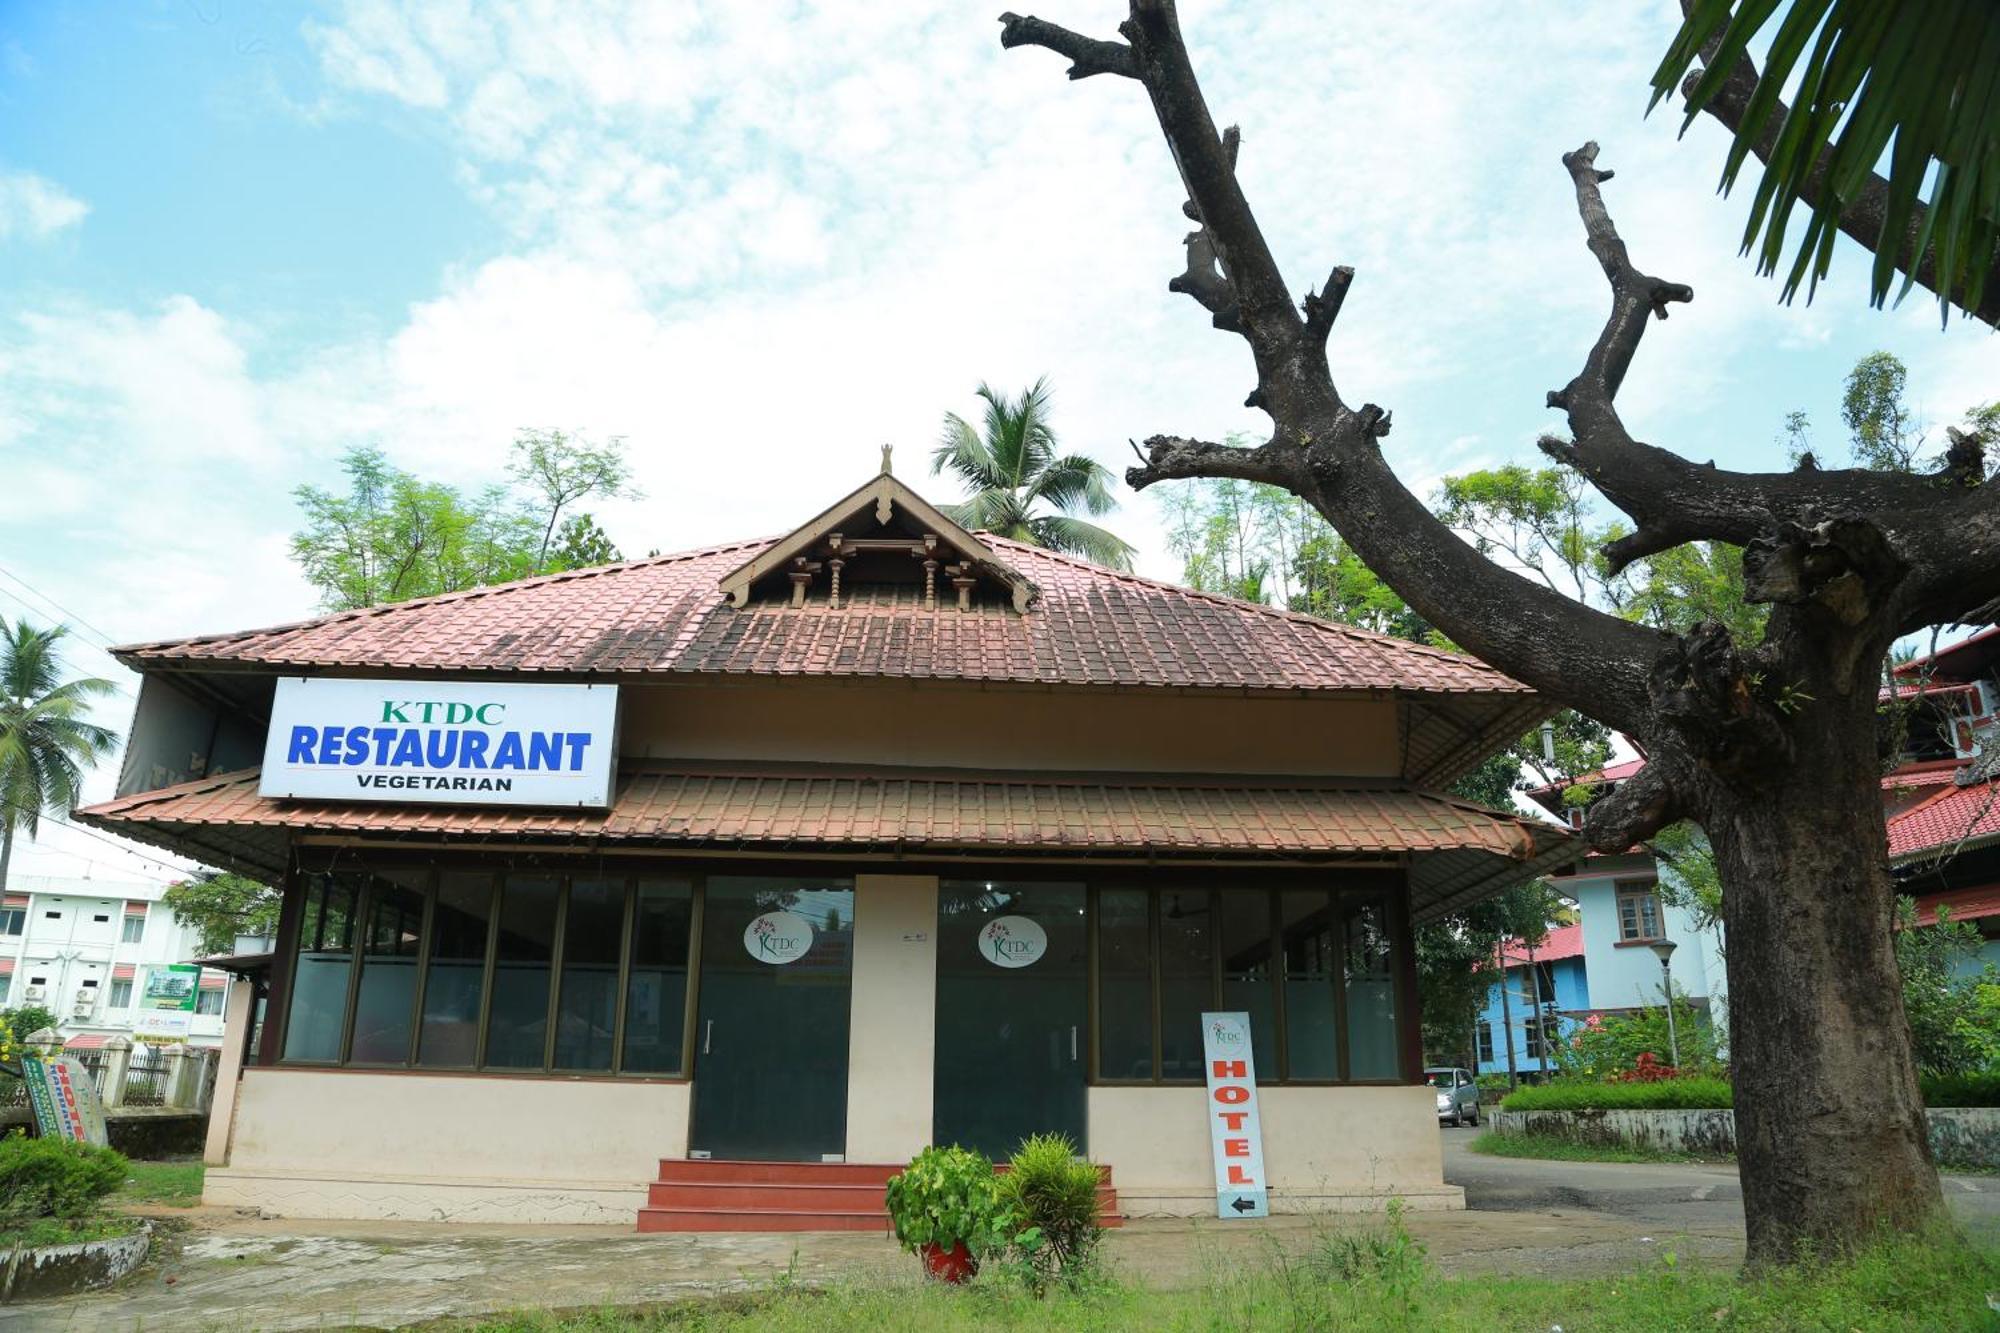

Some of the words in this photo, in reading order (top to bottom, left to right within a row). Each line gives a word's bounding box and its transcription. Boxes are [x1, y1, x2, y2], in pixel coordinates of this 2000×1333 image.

[380, 700, 506, 726] KTDC
[287, 725, 592, 771] RESTAURANT
[357, 774, 512, 791] VEGETARIAN
[759, 933, 800, 958] KTDC
[56, 1063, 86, 1141] HOTE
[1213, 1060, 1255, 1185] HOTEL
